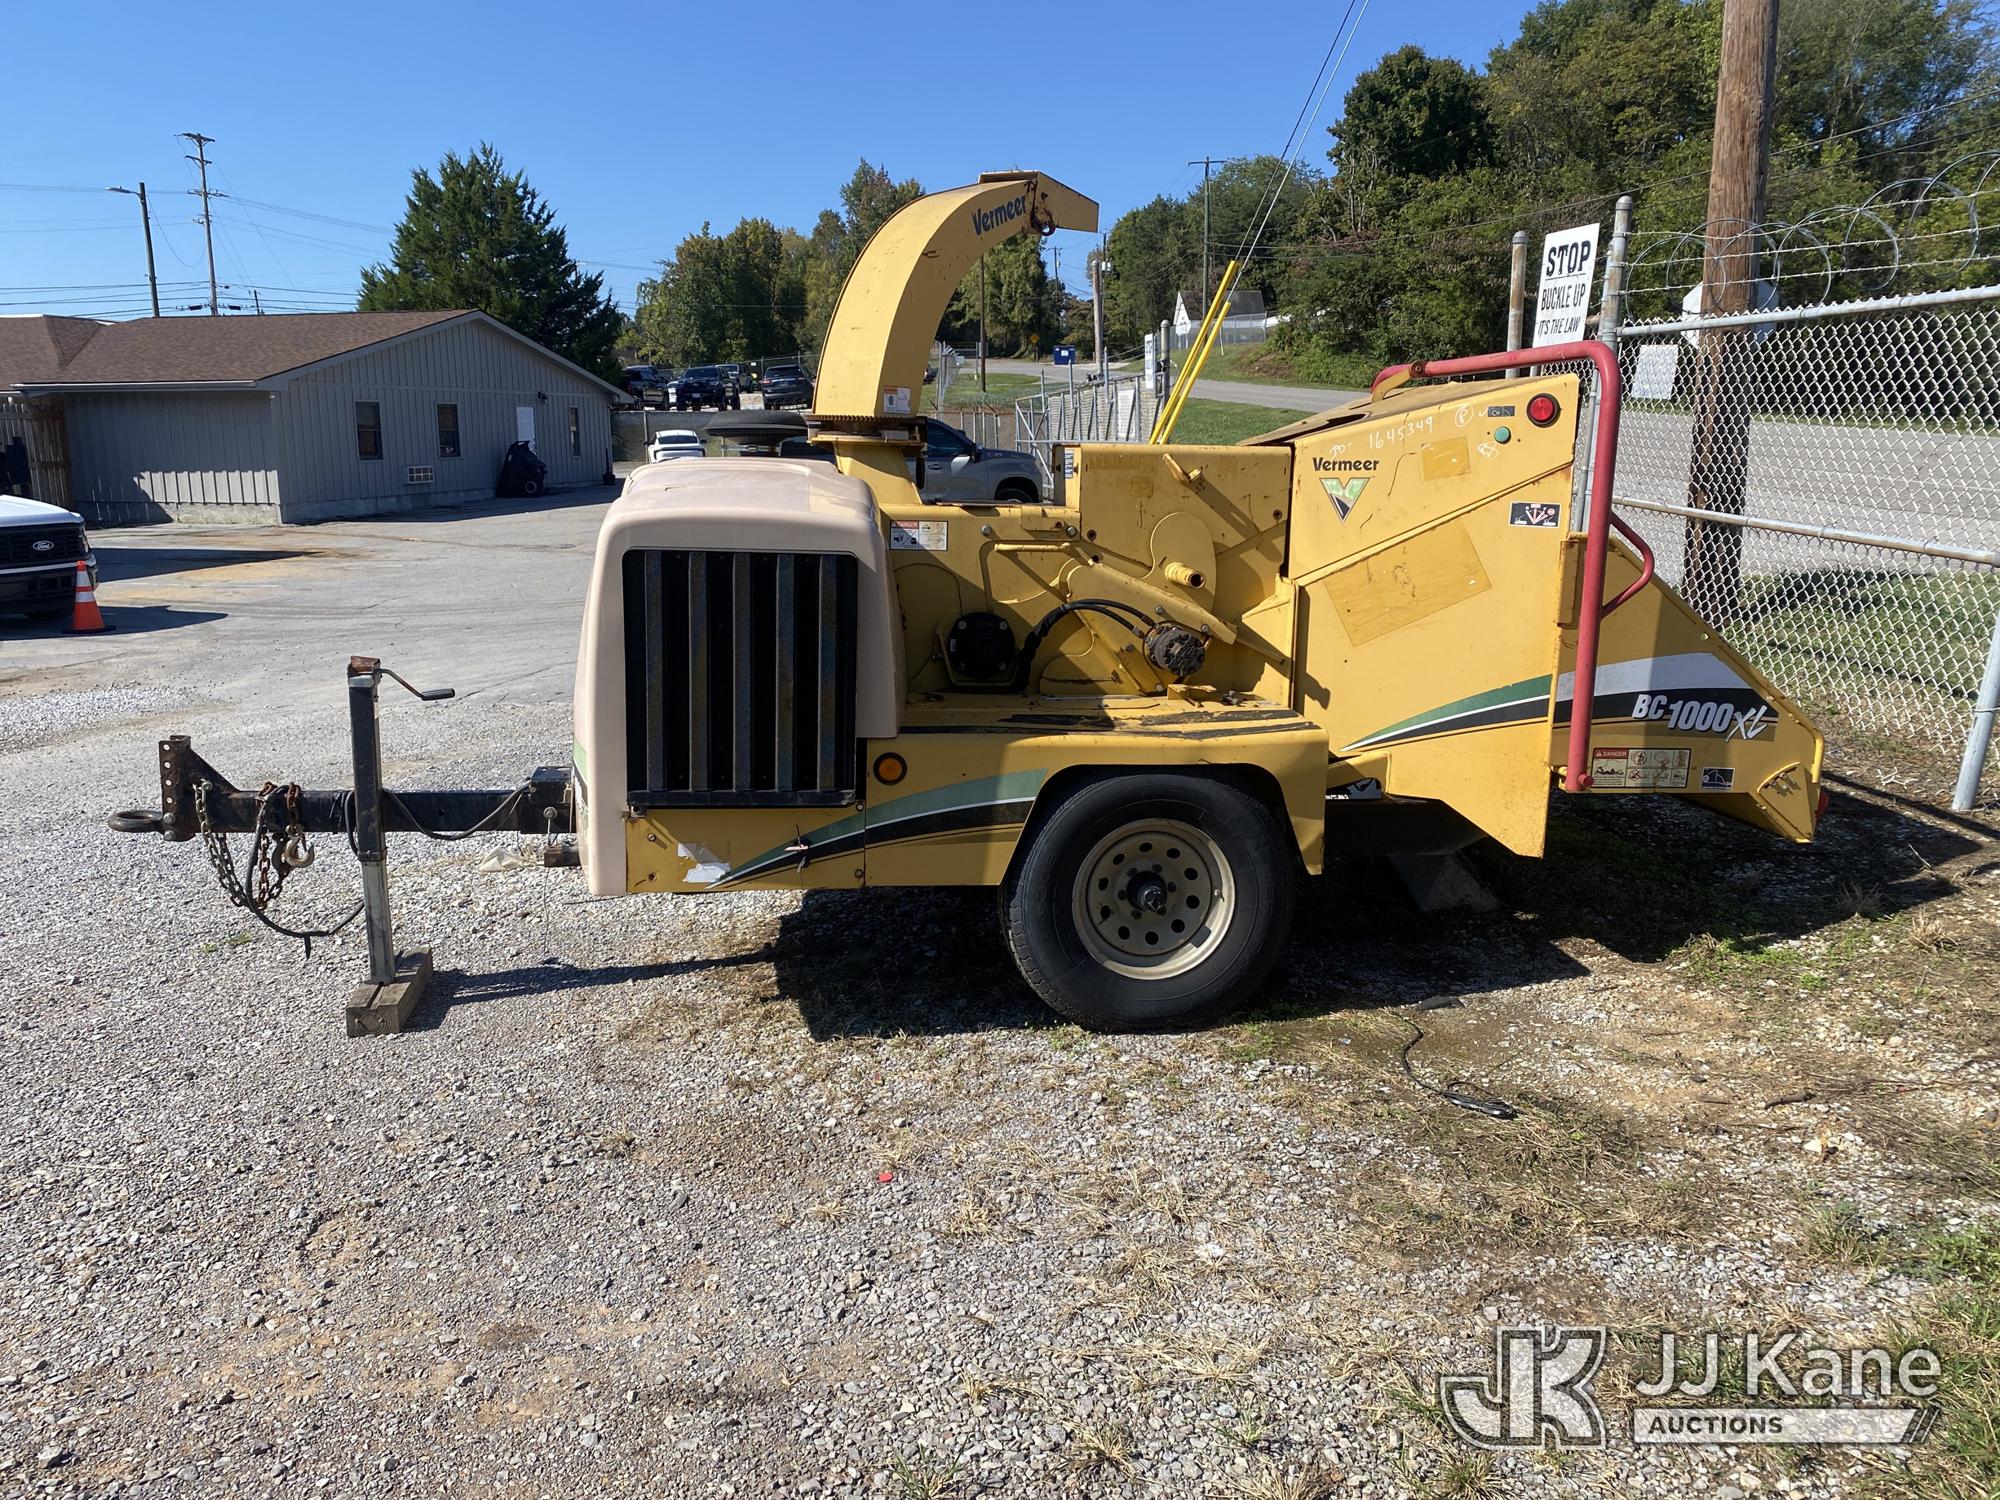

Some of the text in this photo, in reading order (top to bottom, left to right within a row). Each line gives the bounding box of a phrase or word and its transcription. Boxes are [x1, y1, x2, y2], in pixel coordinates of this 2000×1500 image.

[971, 195, 1026, 236] Vermeer
[1545, 240, 1592, 277] STOP
[1541, 283, 1586, 311] BUCKLE UP
[1537, 316, 1581, 336] IT'S THE LAW
[1369, 416, 1433, 449] 1645349
[1312, 456, 1380, 472] Vermeer
